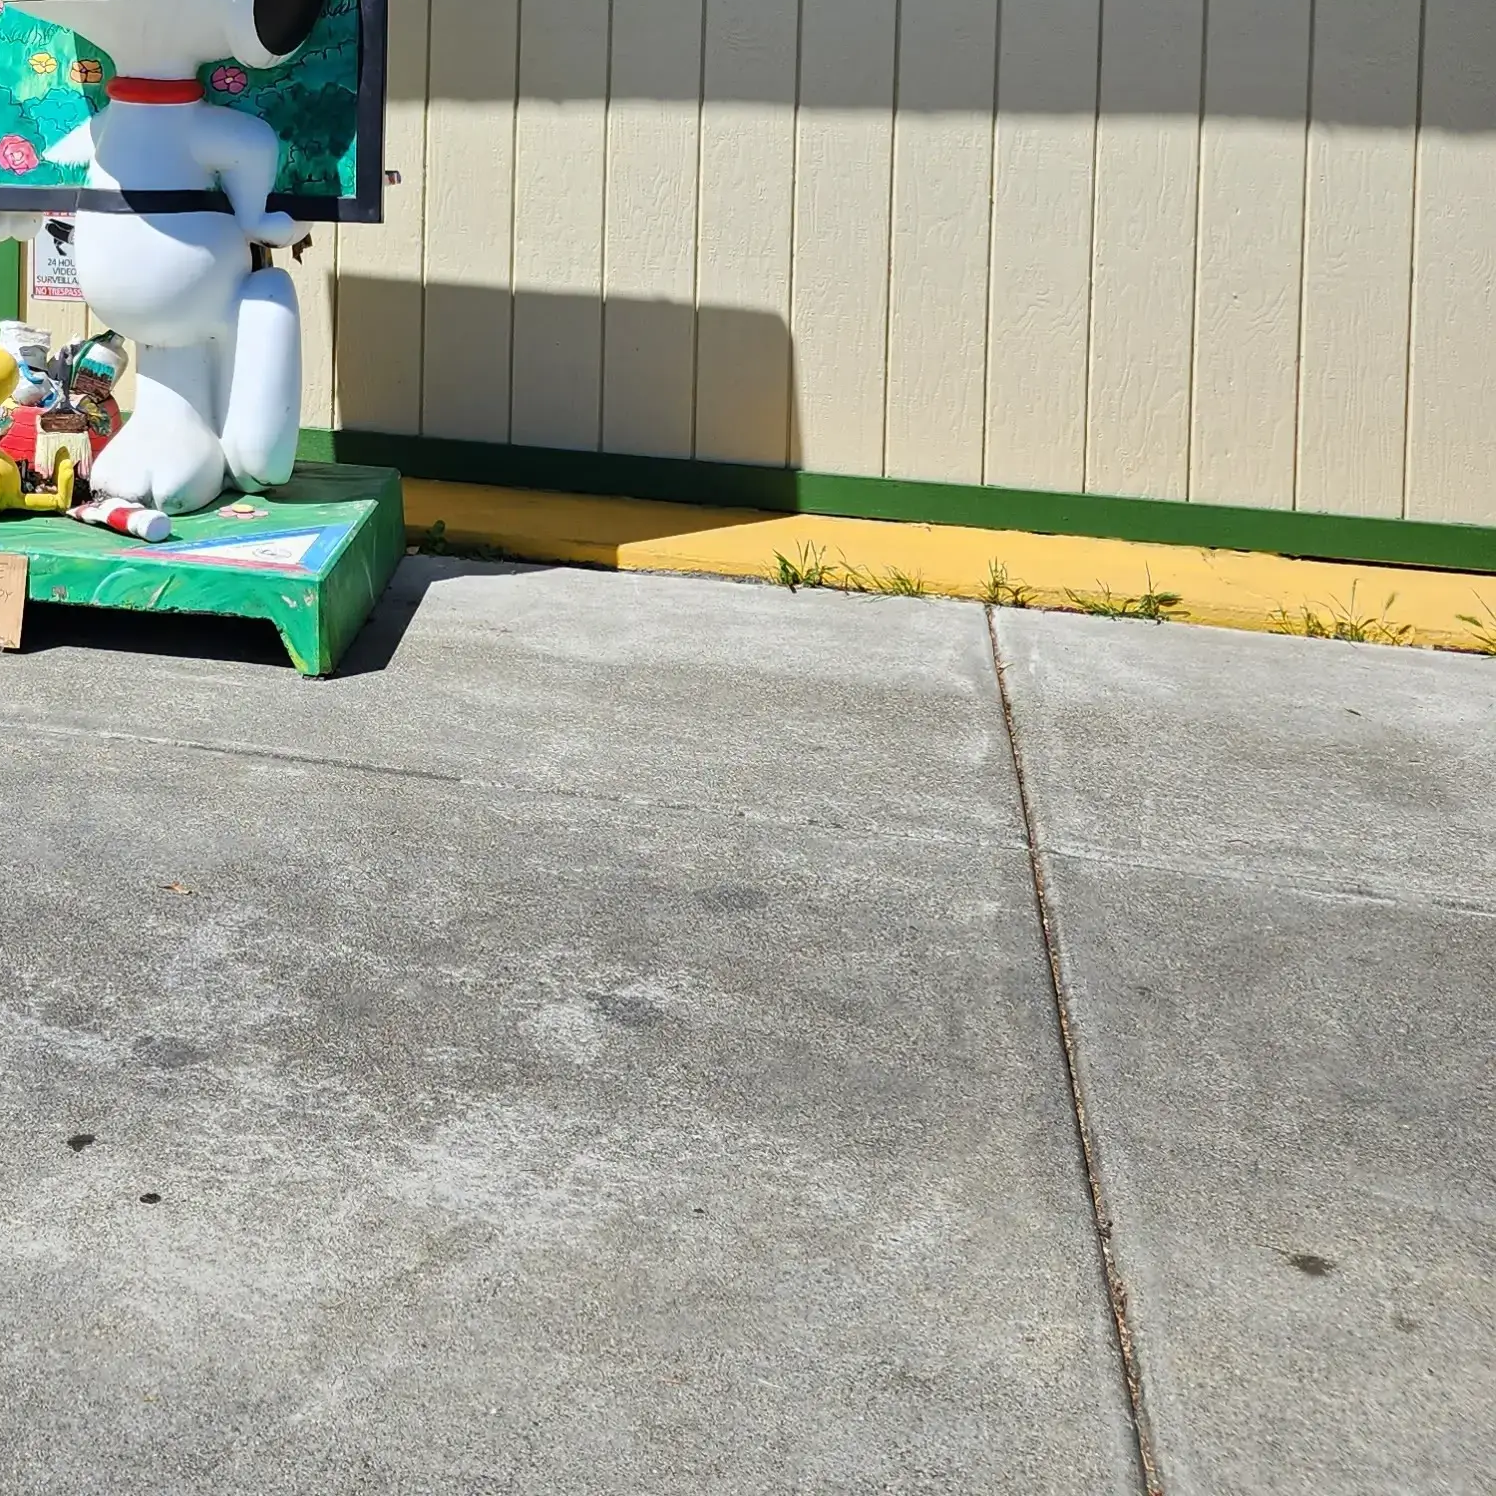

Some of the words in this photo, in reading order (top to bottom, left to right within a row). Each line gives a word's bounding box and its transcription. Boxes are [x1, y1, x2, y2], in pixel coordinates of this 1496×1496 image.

[47, 258, 57, 267] 24
[53, 267, 77, 276] VIDEO
[36, 275, 79, 285] SURVEILLA
[35, 287, 47, 295] NO
[48, 287, 83, 297] TRESPASS
